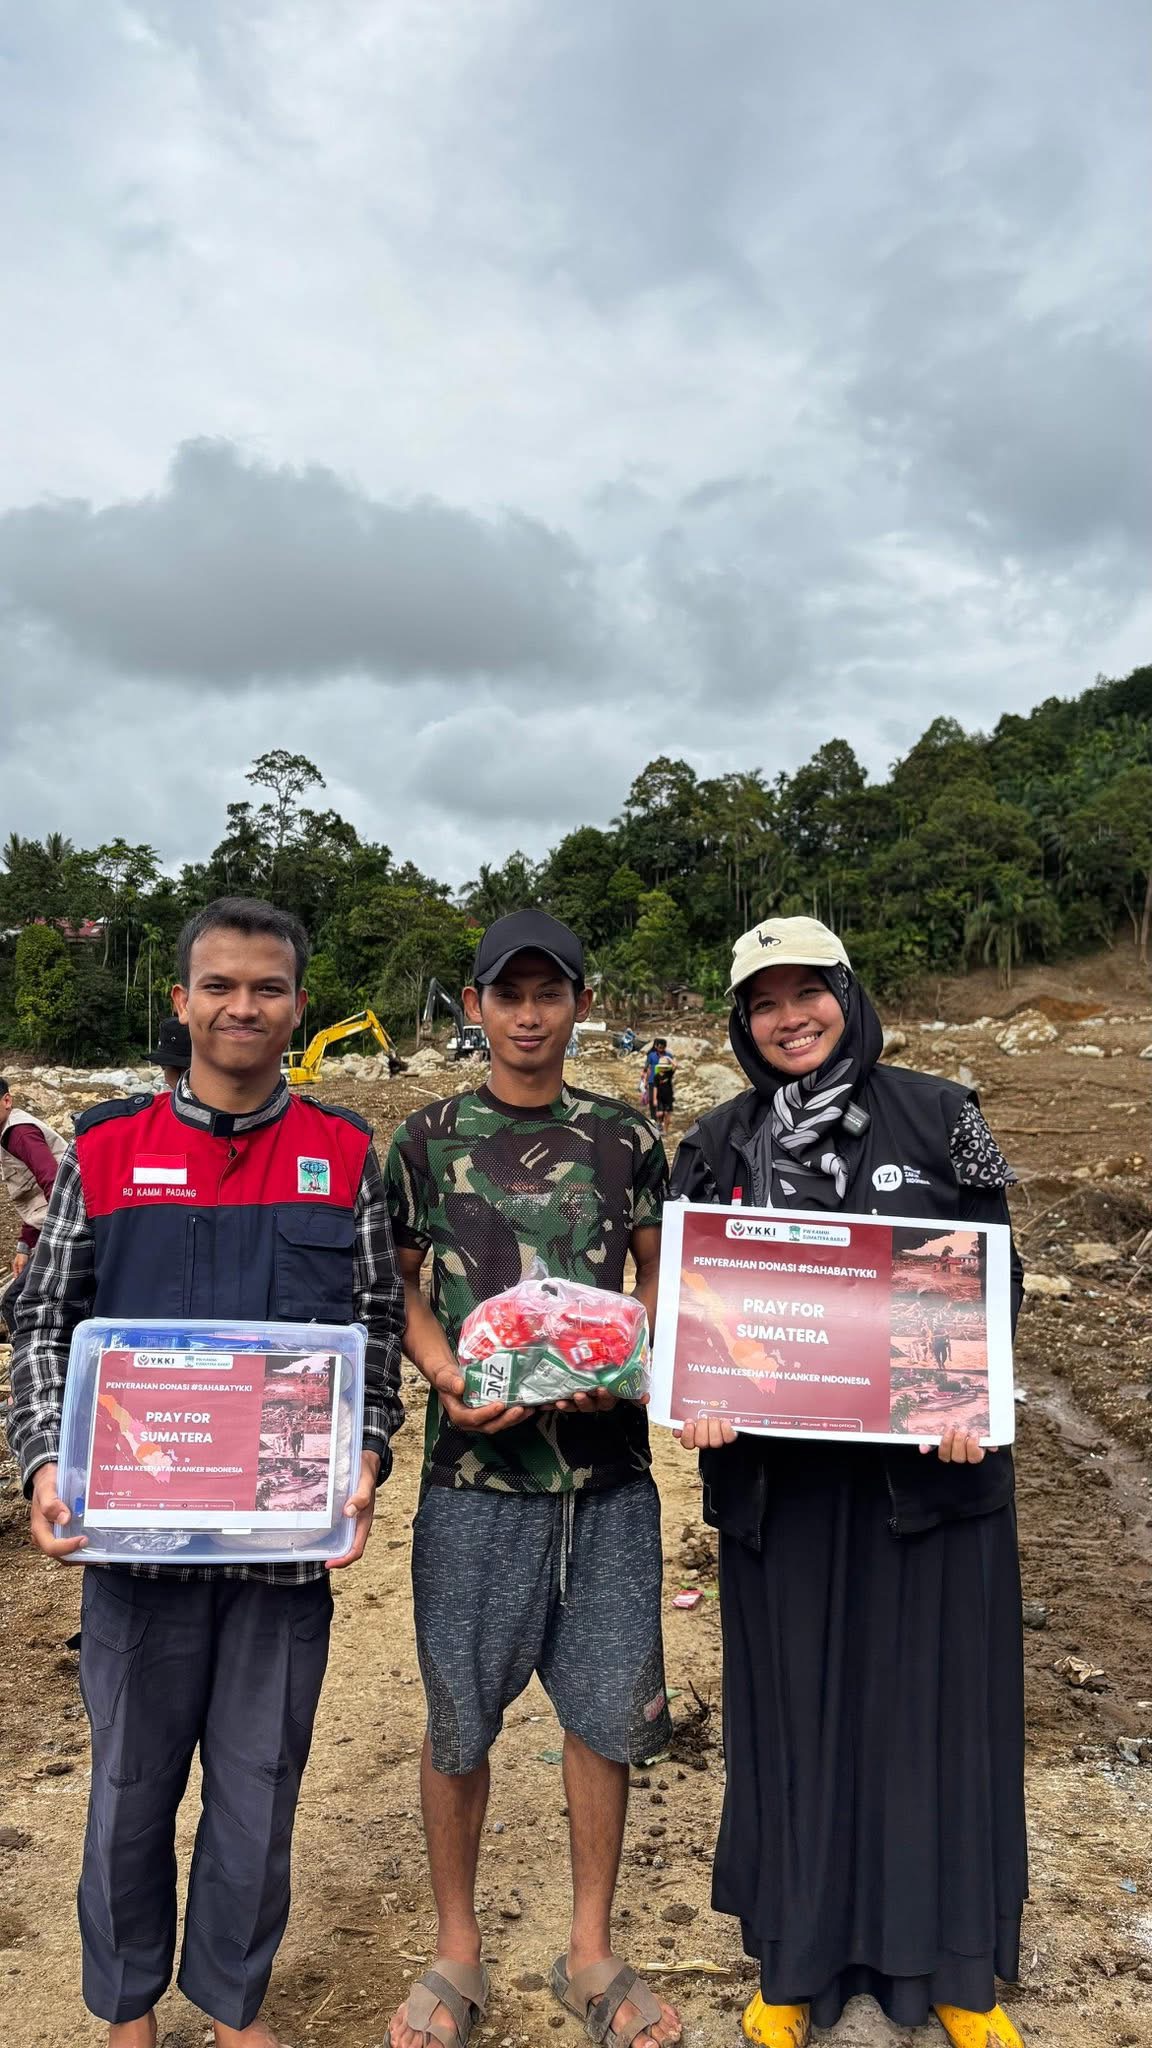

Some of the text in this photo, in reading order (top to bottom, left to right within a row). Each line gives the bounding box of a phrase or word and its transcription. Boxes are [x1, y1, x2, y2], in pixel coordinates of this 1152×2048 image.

[878, 1171, 897, 1184] IZI
[137, 1188, 162, 1197] KAMMI
[166, 1188, 196, 1198] PADANG
[747, 1226, 776, 1236] YKKI
[693, 1256, 877, 1278] PENYERAHAN DONASI #SAHABATYKKI
[743, 1299, 824, 1318] PRAY FOR
[736, 1323, 829, 1344] SUMATERA
[151, 1357, 175, 1365] YKKI
[687, 1363, 870, 1385] YAYASAN KESEHATAN KANKER INDONESIA
[106, 1382, 252, 1392] PENYERAHAN DONASI #SAHABATYKKI
[146, 1411, 211, 1424] PRAY FOR
[140, 1431, 213, 1443] SUMATERA
[135, 1465, 175, 1473] KESEHATAN
[206, 1466, 243, 1474] INDONESIA
